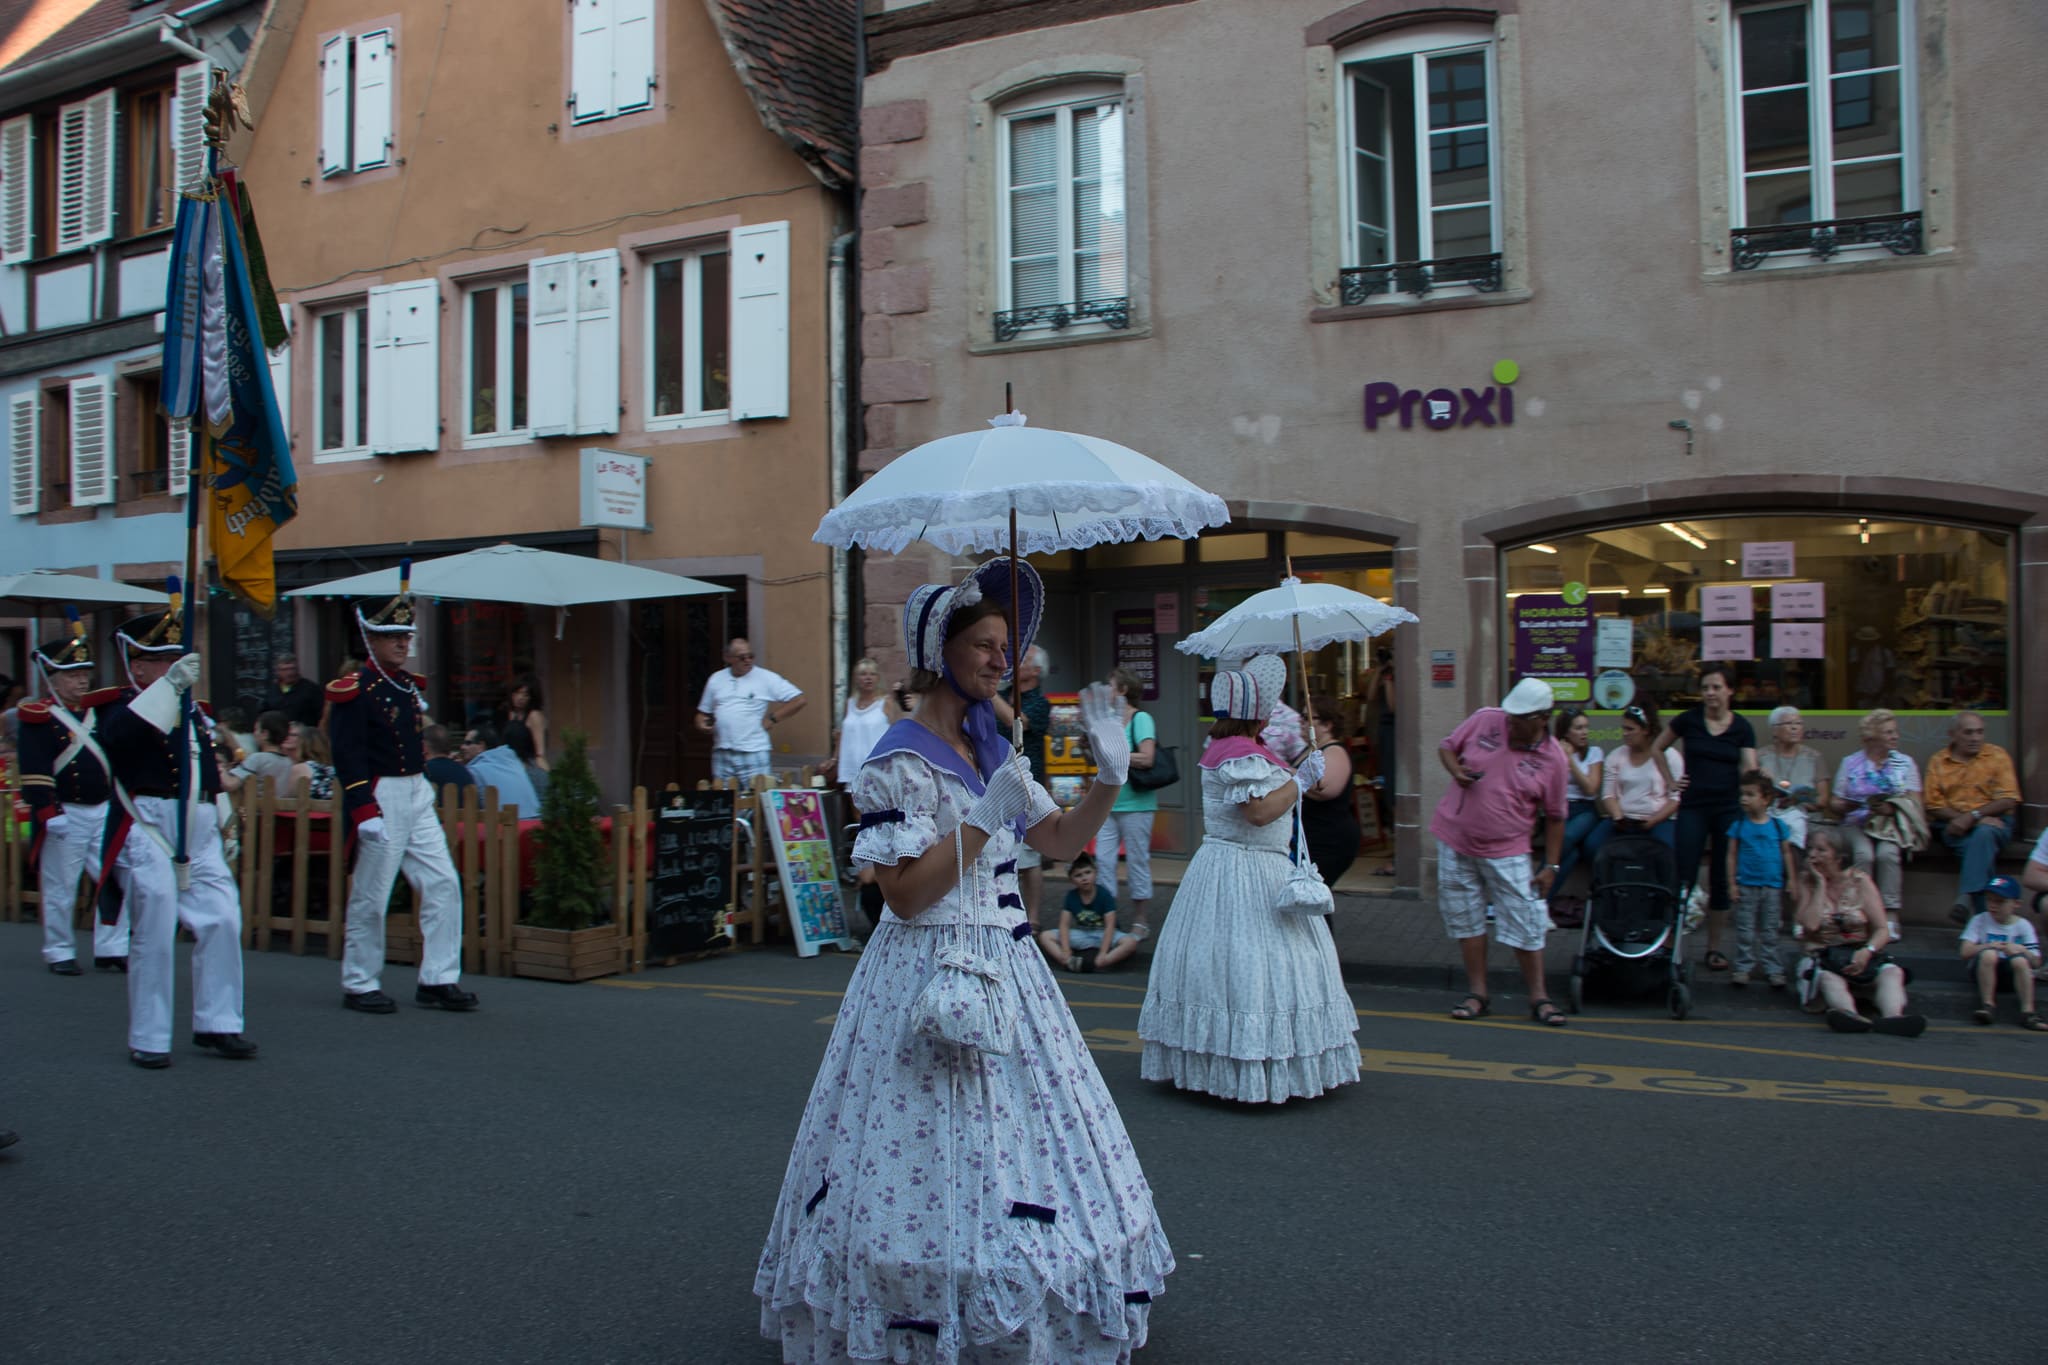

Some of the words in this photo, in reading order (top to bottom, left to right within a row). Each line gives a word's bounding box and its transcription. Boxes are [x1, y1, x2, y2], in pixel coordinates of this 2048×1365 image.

[228, 350, 250, 387] 982
[1364, 358, 1520, 431] Proxi
[225, 460, 281, 537] aldkirch
[1519, 607, 1588, 618] HORAIRES
[1118, 633, 1154, 646] PAINS
[1588, 727, 1624, 742] apid
[1804, 728, 1848, 740] cheur
